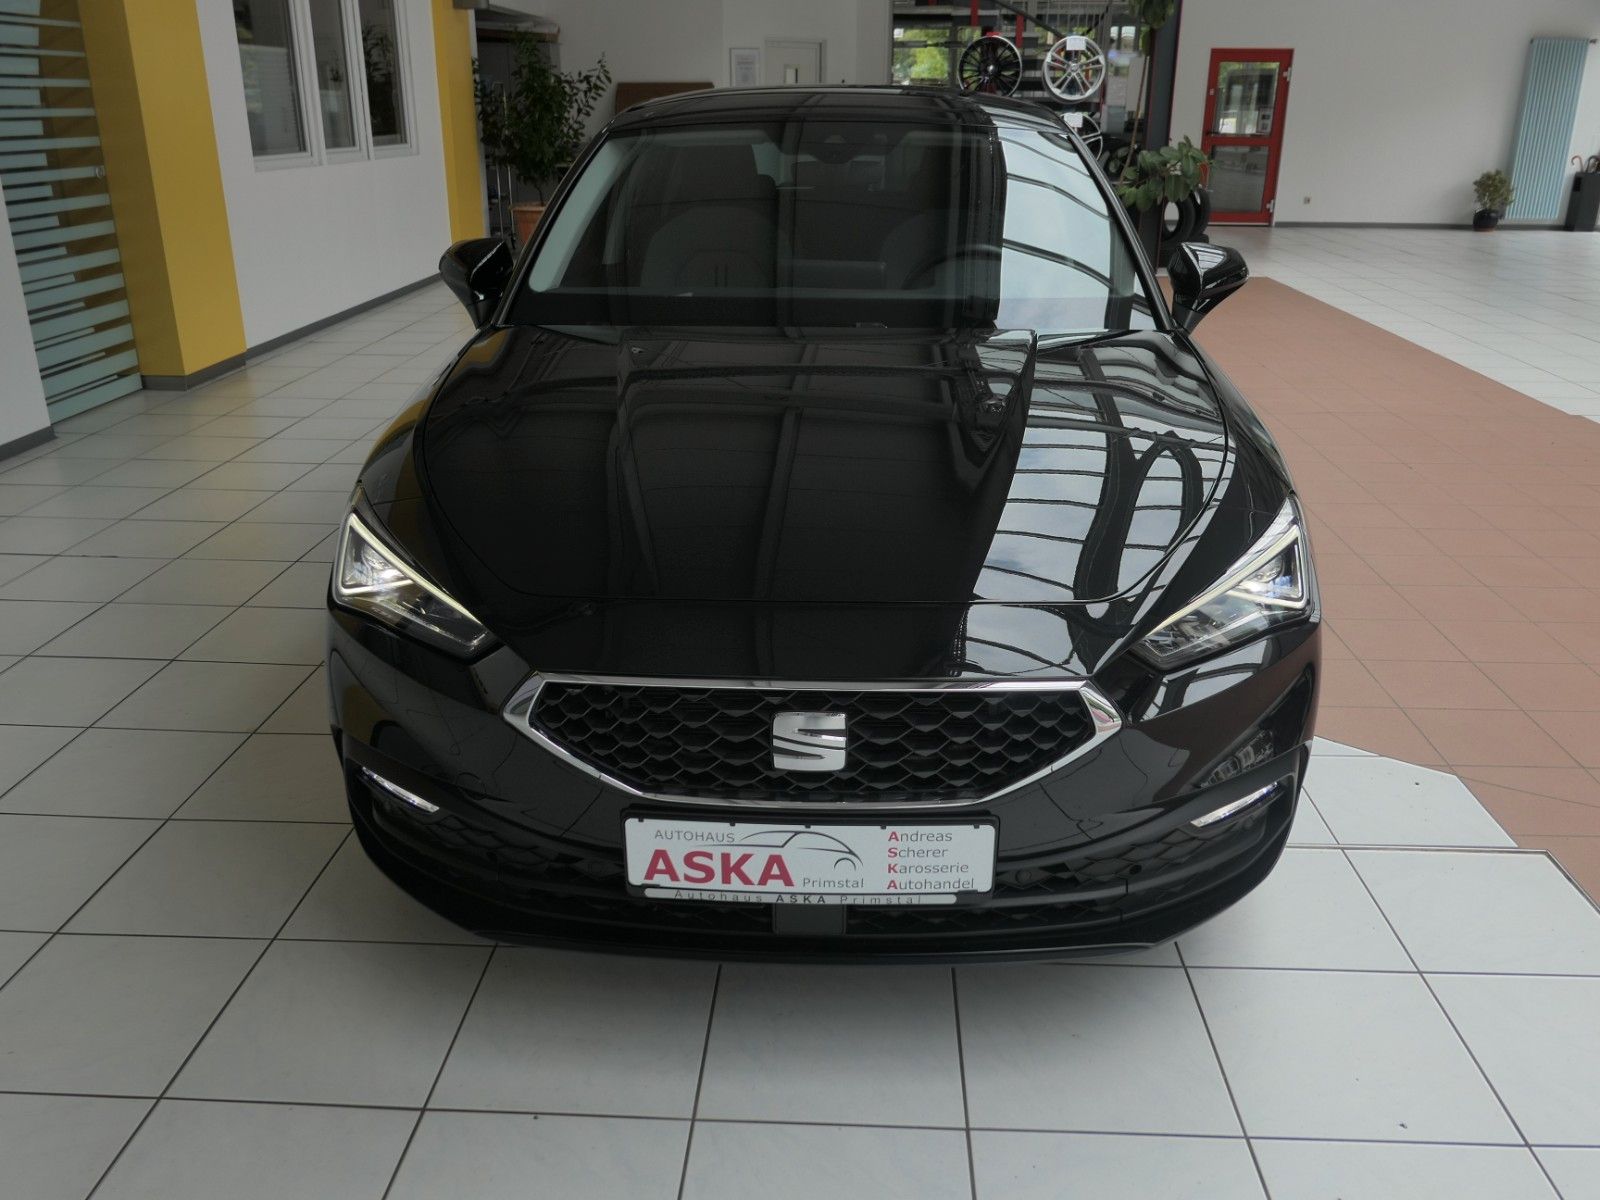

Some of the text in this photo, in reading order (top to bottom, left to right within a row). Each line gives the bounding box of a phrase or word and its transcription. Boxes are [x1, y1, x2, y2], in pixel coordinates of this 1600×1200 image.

[654, 829, 736, 843] AUTOHAUS
[887, 831, 953, 842] Andreas
[887, 847, 949, 858] Scherer
[644, 849, 795, 887] ASKA
[887, 862, 969, 874] Karosserie
[803, 877, 865, 888] Primstal
[887, 878, 974, 890] Autohandel
[674, 890, 921, 904] Autohaus ASKA Primstal
